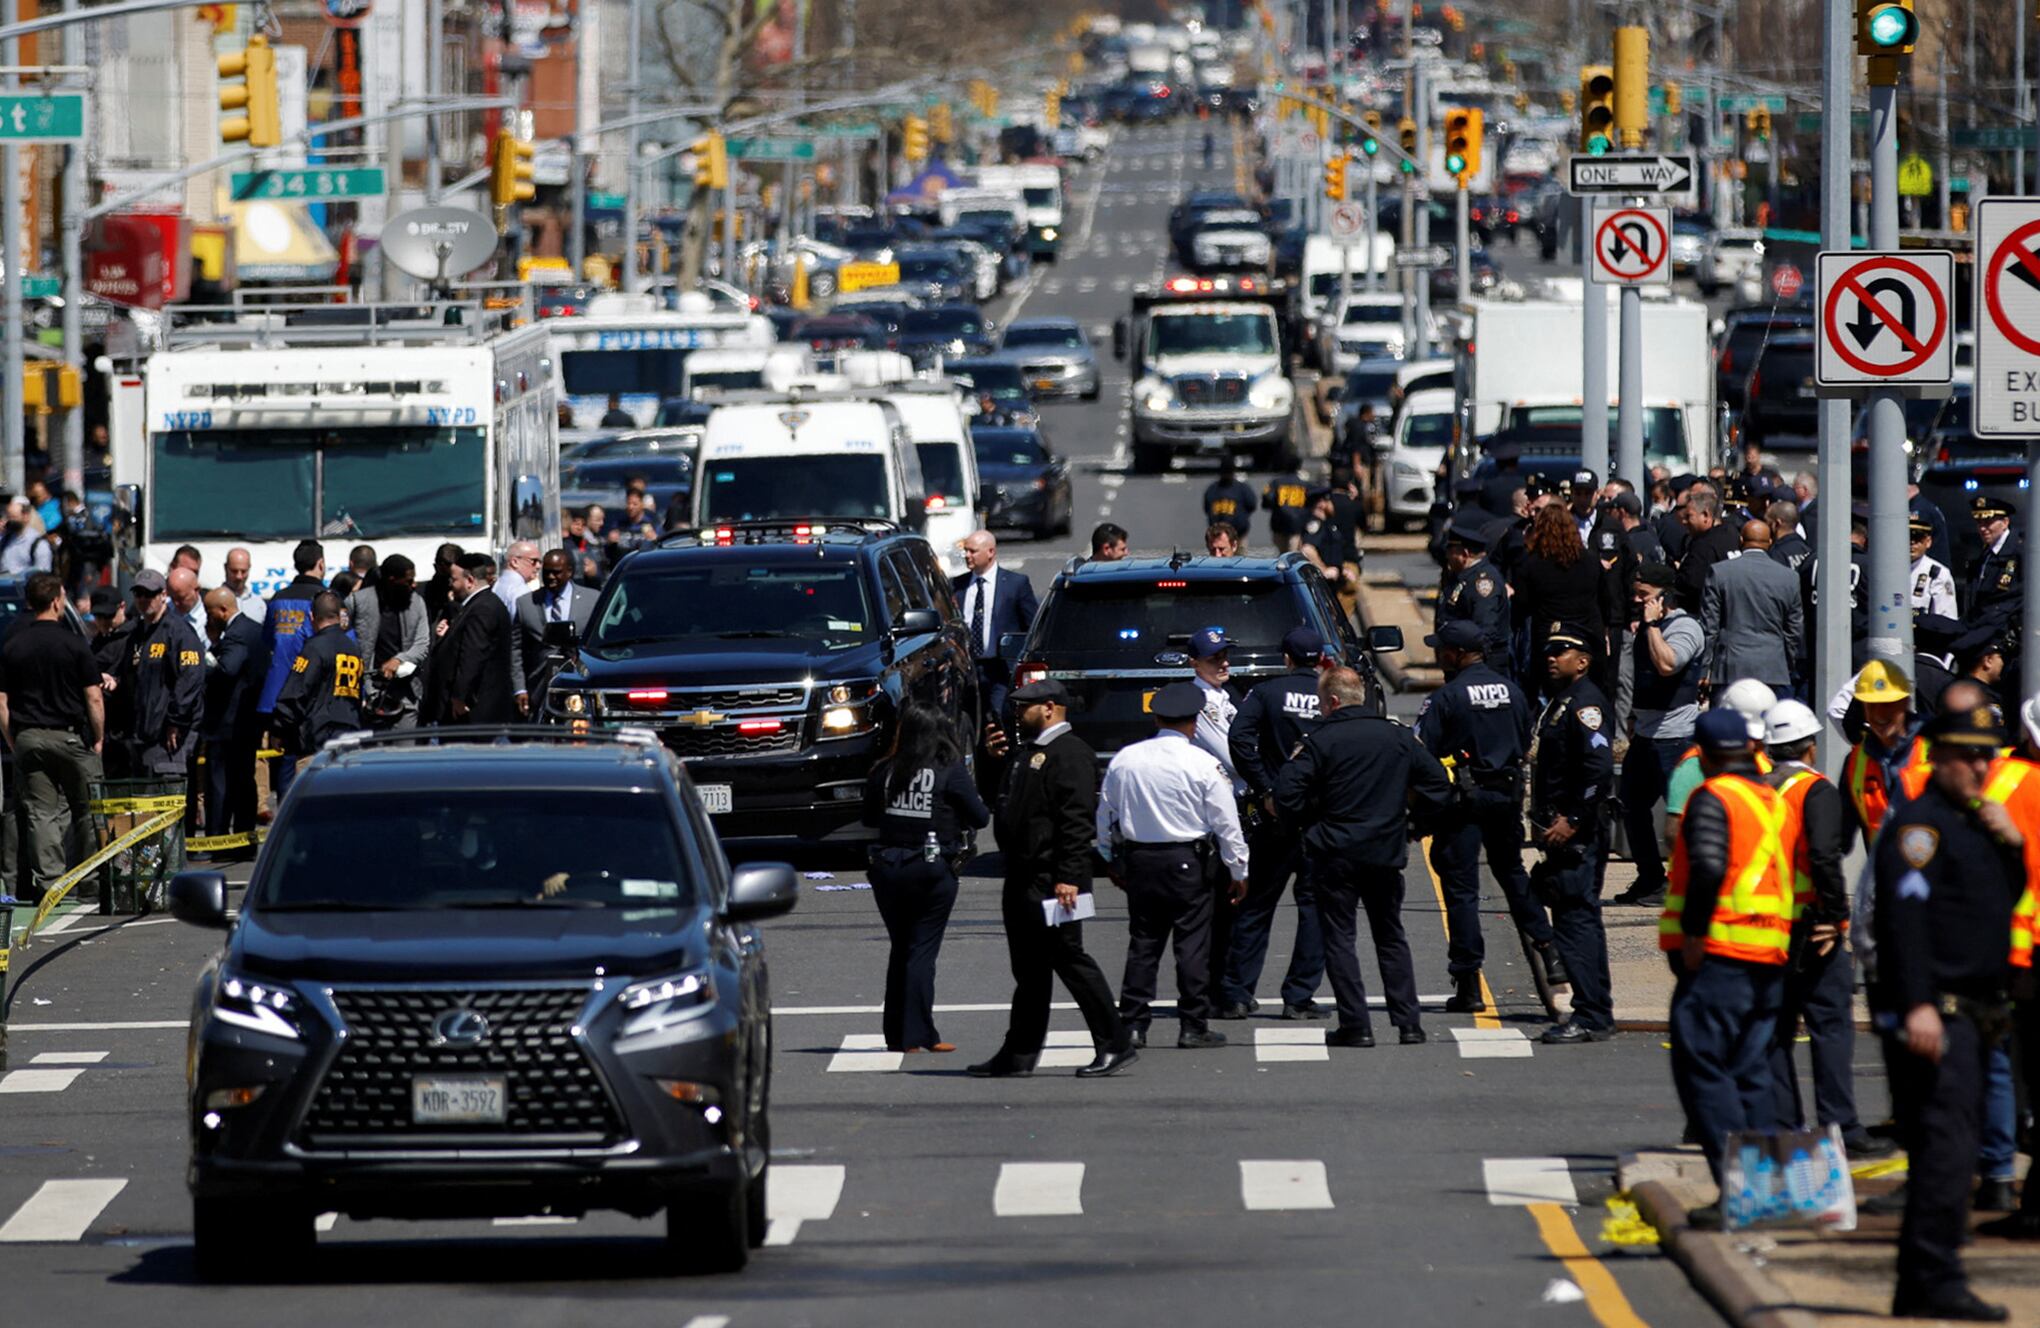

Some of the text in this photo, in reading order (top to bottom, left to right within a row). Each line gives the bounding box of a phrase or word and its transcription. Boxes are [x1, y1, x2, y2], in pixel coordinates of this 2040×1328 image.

[0, 102, 26, 132] t
[267, 172, 348, 197] 34 St
[1580, 167, 1677, 183] ONE WAY
[598, 329, 704, 349] POLICE
[2007, 371, 2040, 392] EX
[163, 412, 213, 430] NYPD
[426, 404, 477, 425] NYPD
[2013, 401, 2040, 422] BU
[1285, 691, 1321, 710] NYP
[1466, 683, 1510, 700] NYPD
